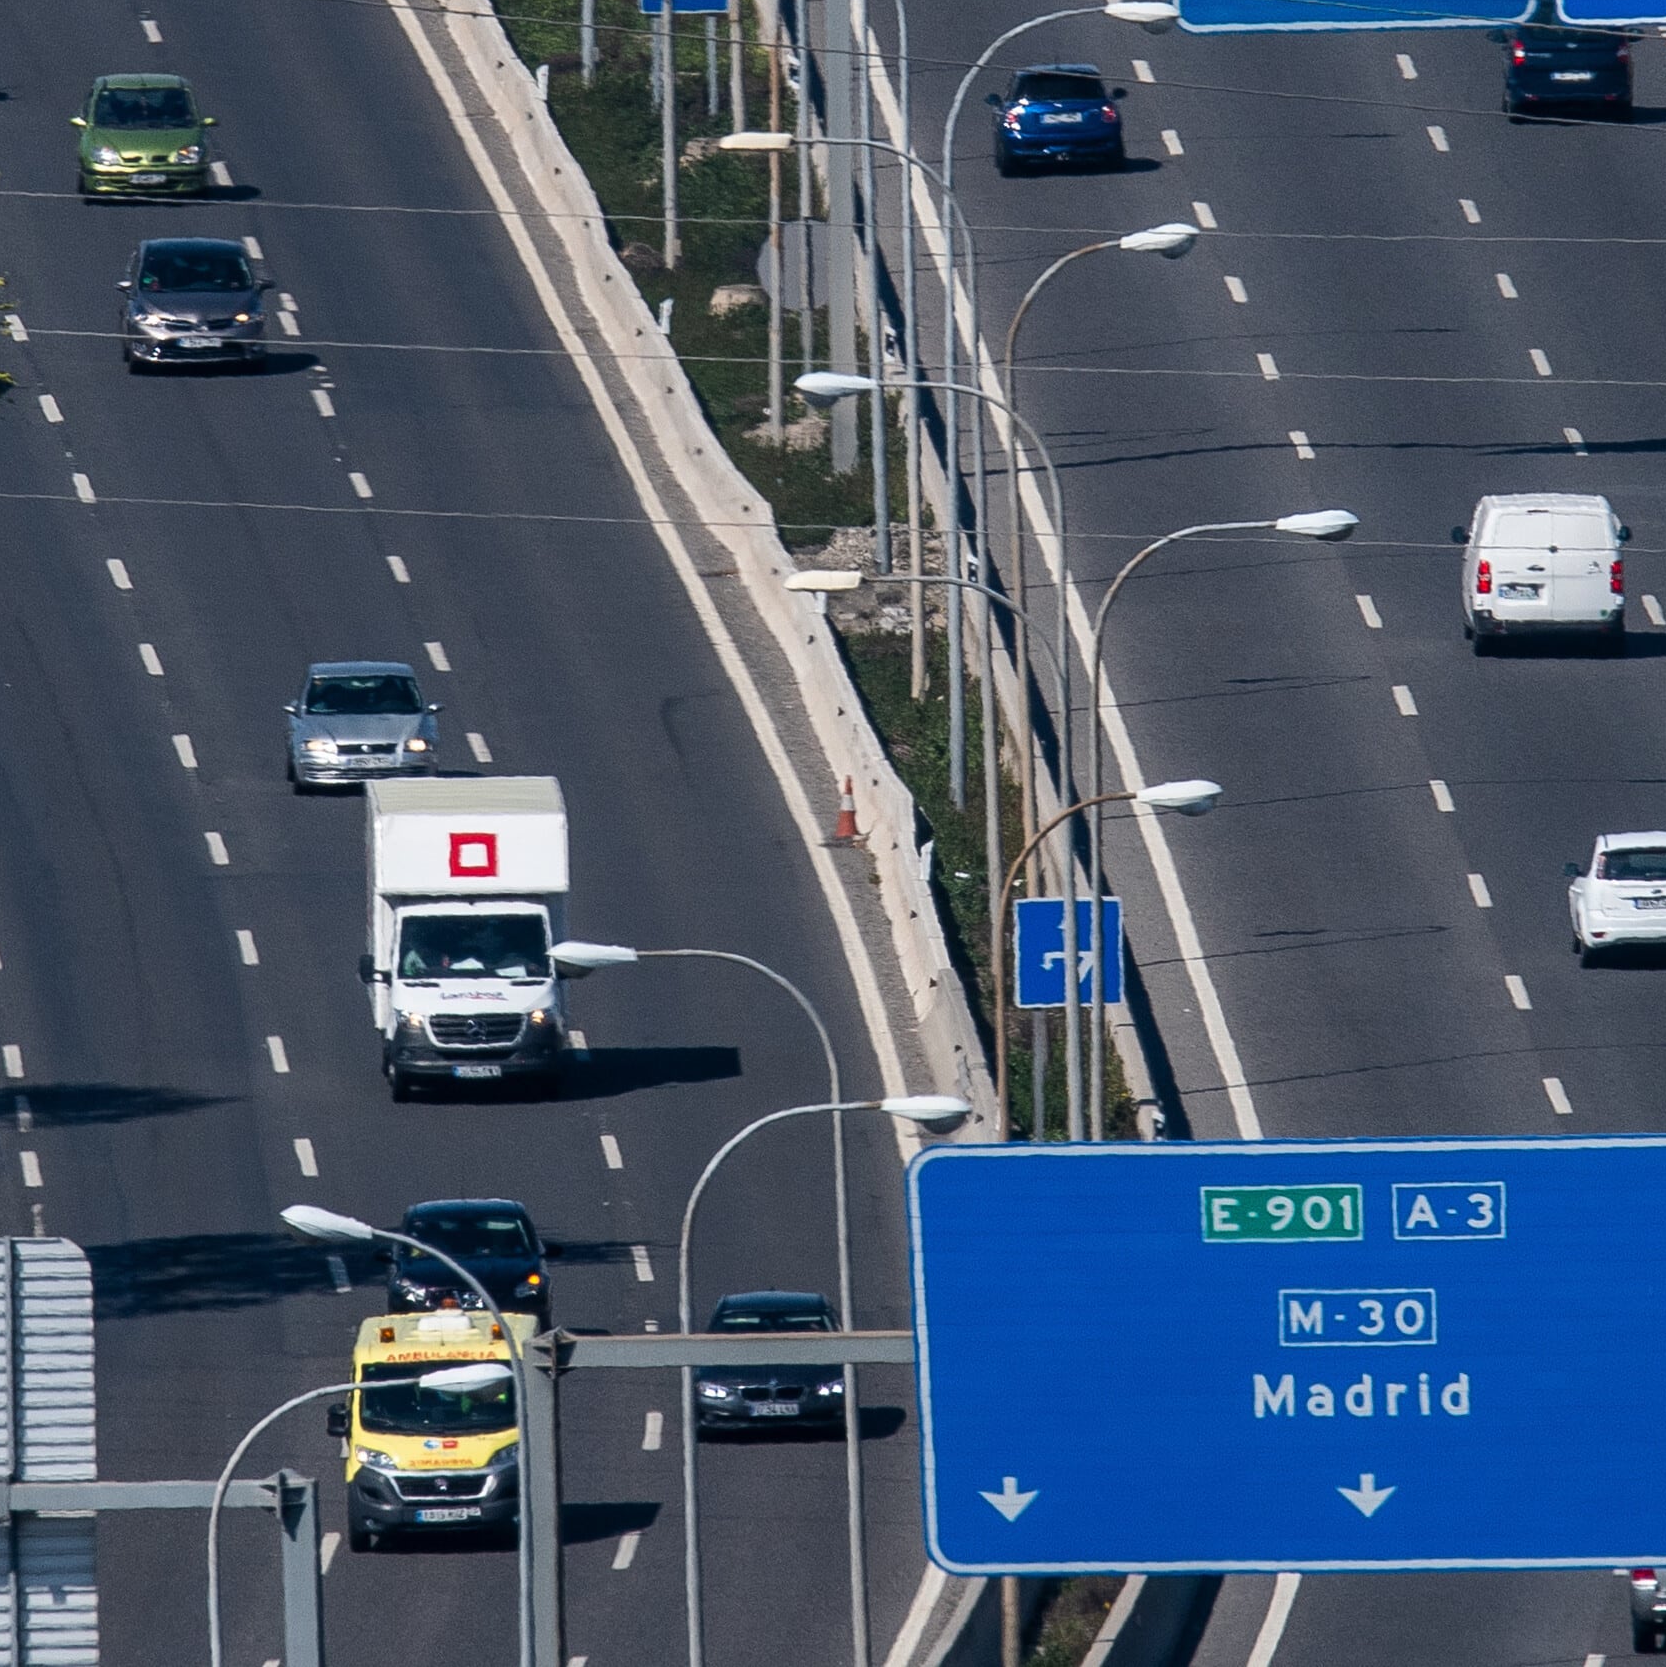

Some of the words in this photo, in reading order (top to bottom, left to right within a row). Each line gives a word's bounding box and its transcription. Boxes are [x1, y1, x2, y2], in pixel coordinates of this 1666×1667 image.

[1210, 1194, 1356, 1231] E-901
[1404, 1193, 1494, 1230] A-3
[1287, 1299, 1425, 1336] M-30
[1252, 1373, 1472, 1419] Madrid
